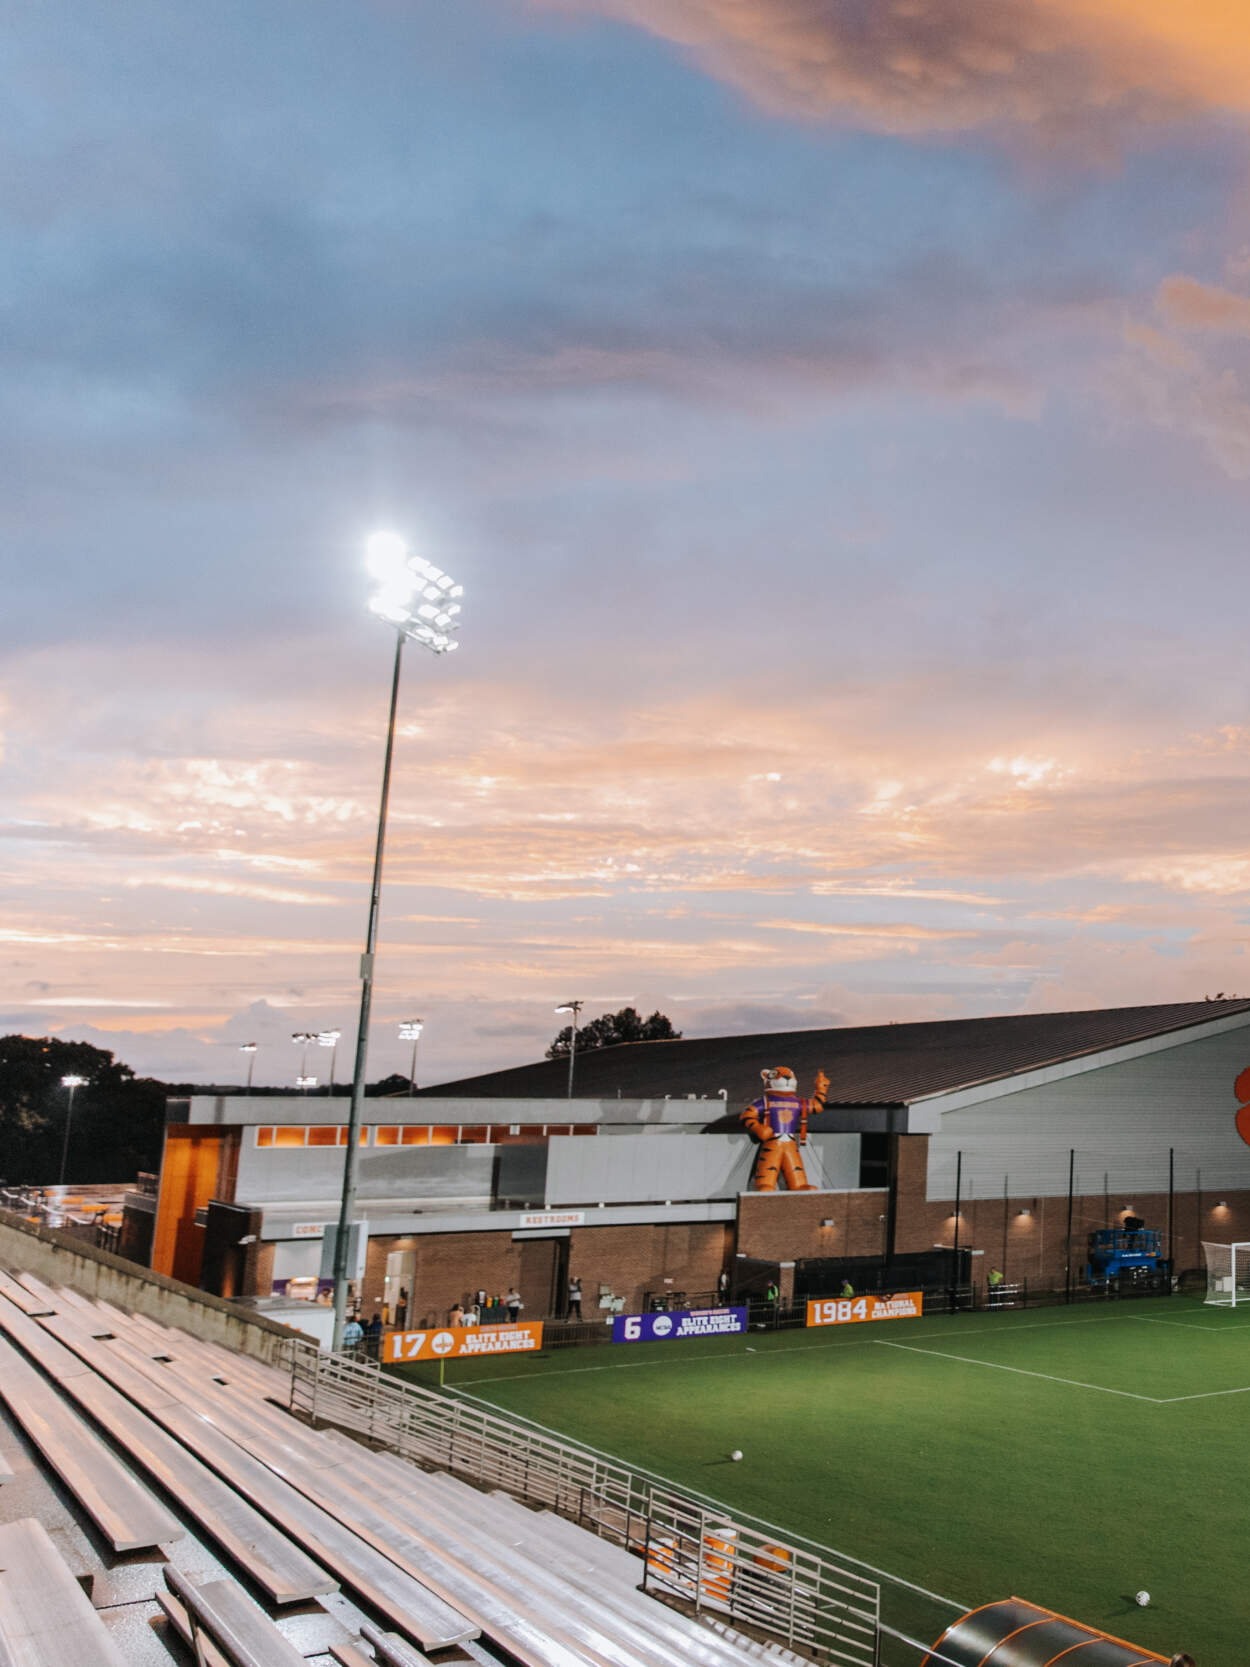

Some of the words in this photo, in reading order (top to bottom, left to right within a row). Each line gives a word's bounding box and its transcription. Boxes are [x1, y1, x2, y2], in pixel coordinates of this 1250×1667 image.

[814, 1299, 867, 1323] 1984
[874, 1299, 914, 1310] NATIONAL
[871, 1307, 917, 1318] CHAMPIONS
[624, 1316, 642, 1339] 6
[676, 1322, 741, 1336] APPEARANCES
[392, 1333, 426, 1358] 17
[466, 1332, 497, 1345] ELITE
[459, 1339, 535, 1353] APPEARANCES
